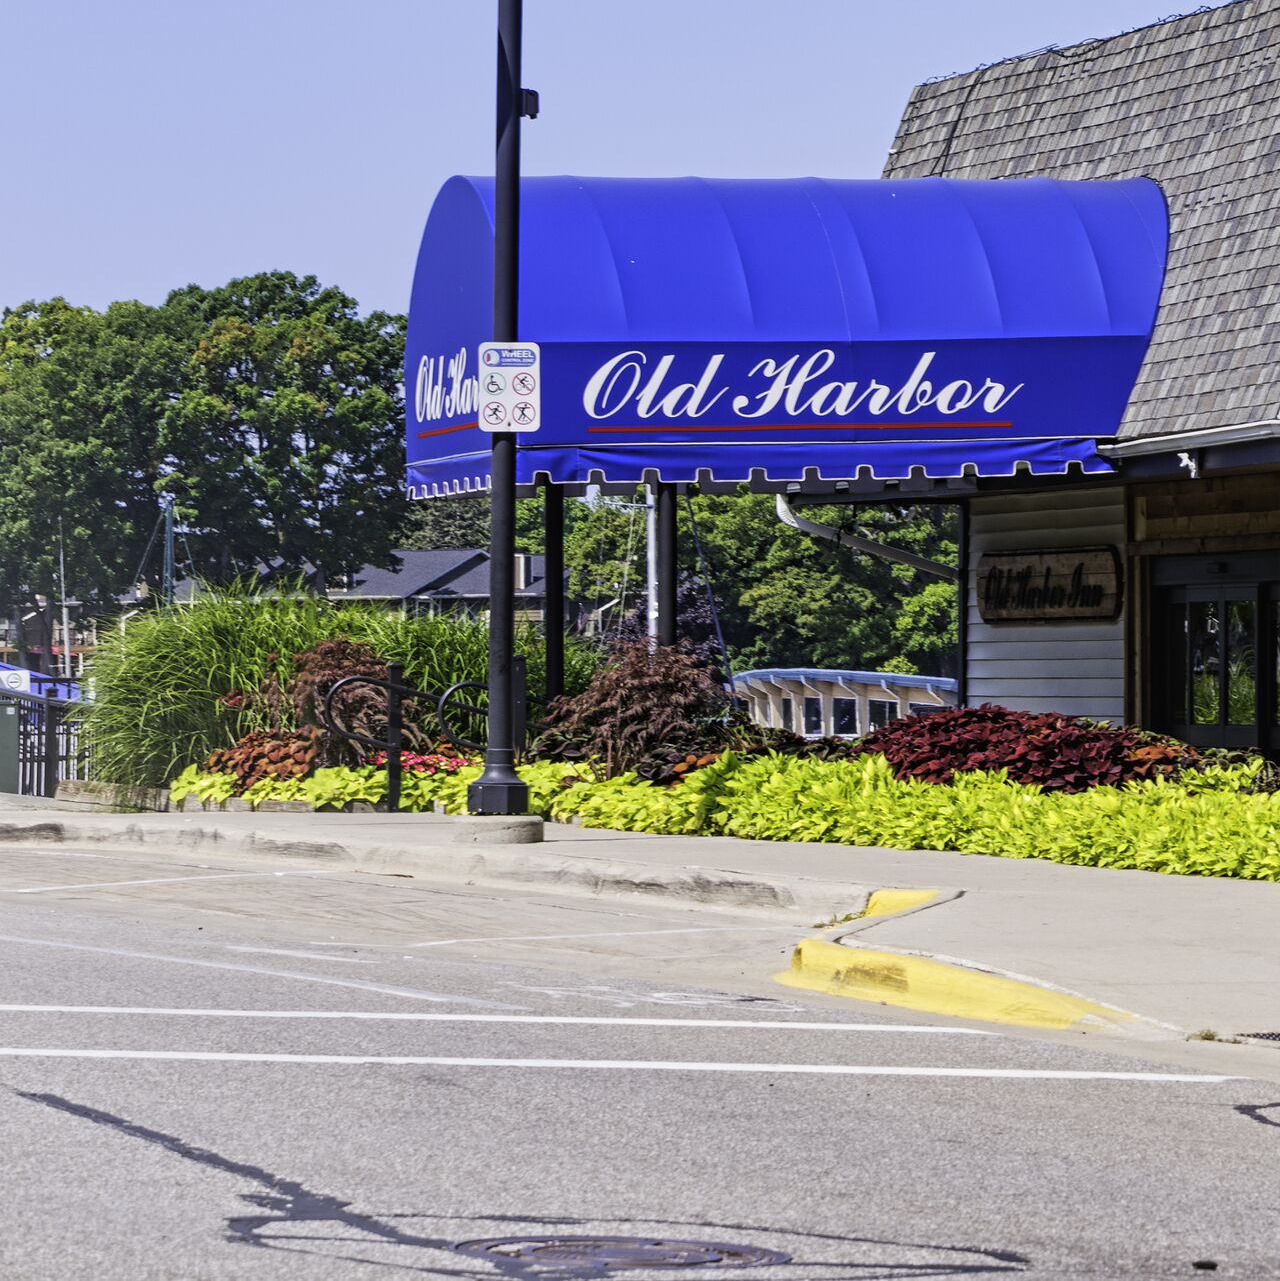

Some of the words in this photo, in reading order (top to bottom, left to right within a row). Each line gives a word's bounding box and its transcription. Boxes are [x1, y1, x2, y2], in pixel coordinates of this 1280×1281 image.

[416, 354, 446, 422] Old
[502, 350, 534, 358] WHEEL
[583, 350, 729, 419] Old
[733, 348, 1025, 418] Harbor
